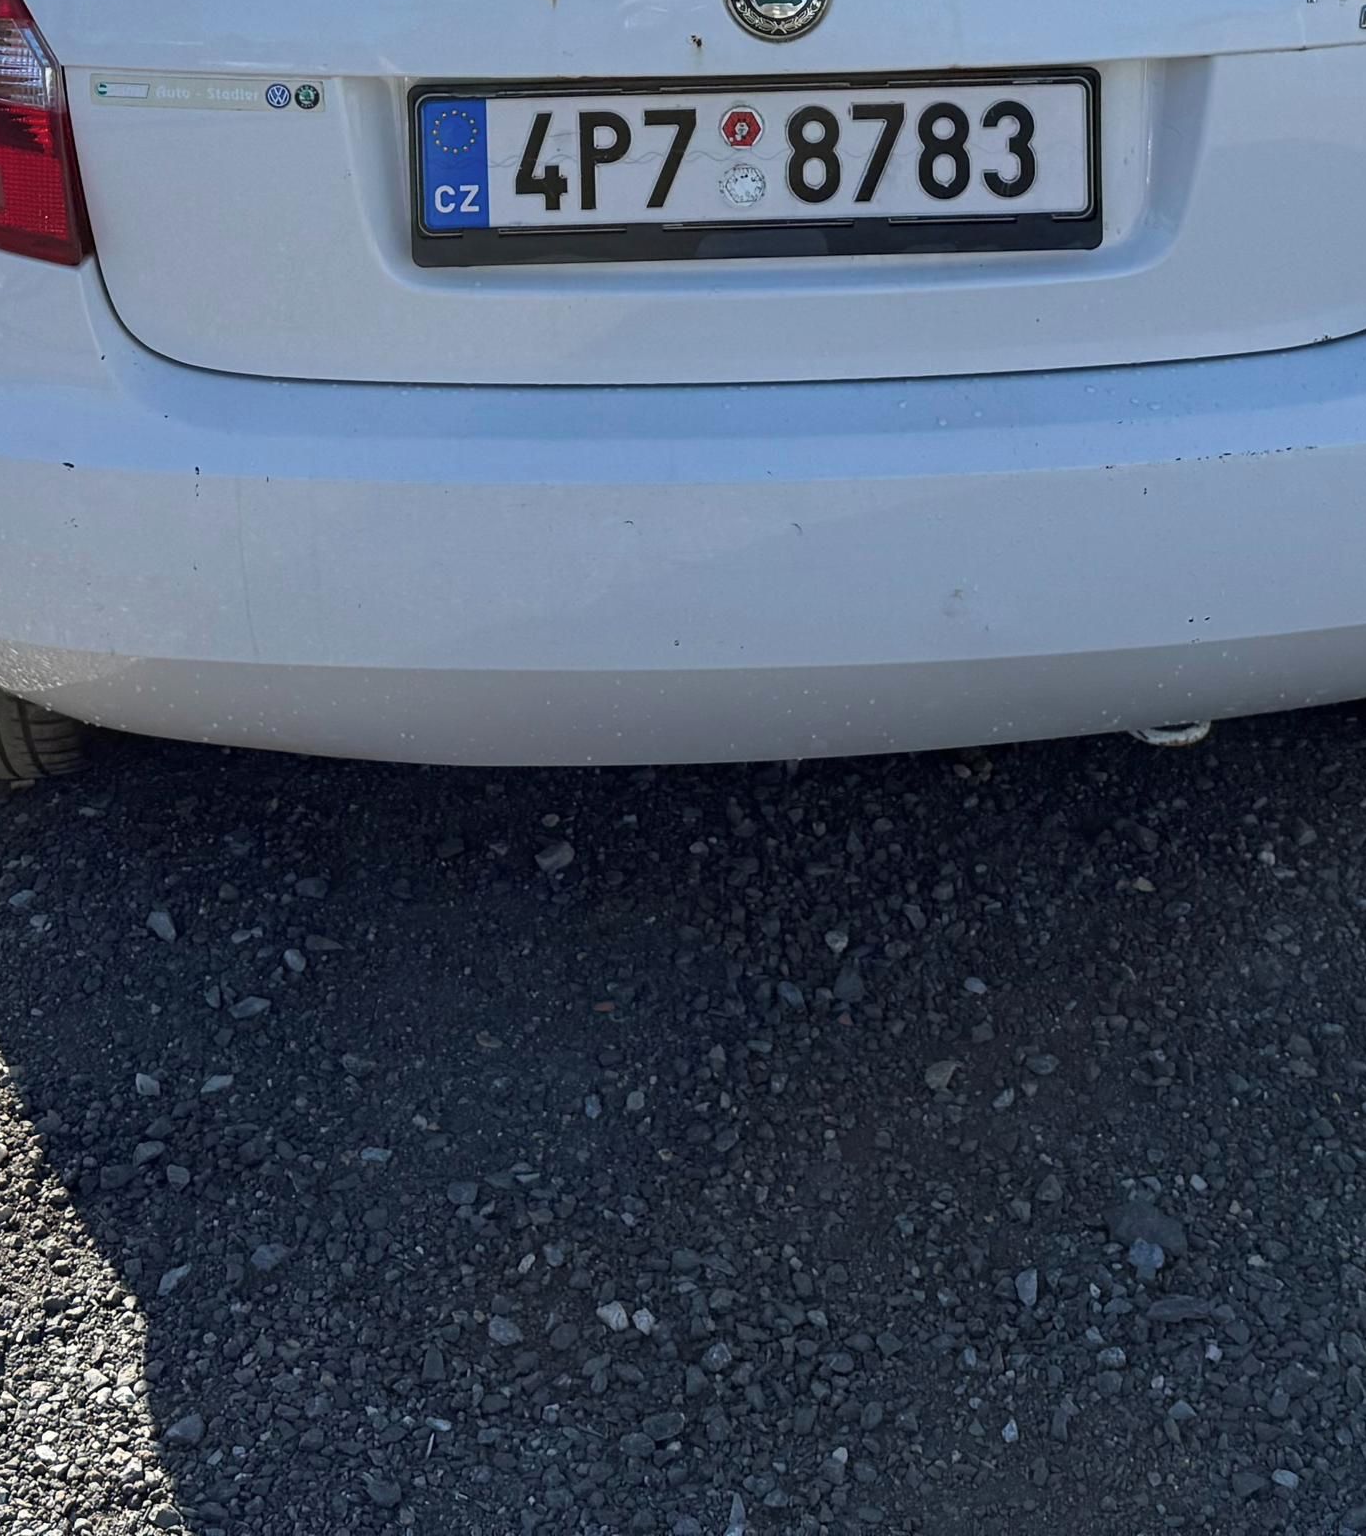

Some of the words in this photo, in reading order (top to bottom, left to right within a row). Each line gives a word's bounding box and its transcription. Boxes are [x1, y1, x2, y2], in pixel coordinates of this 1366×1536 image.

[514, 108, 697, 212] 4P7
[785, 99, 1037, 205] 8783
[434, 184, 480, 214] CZ
